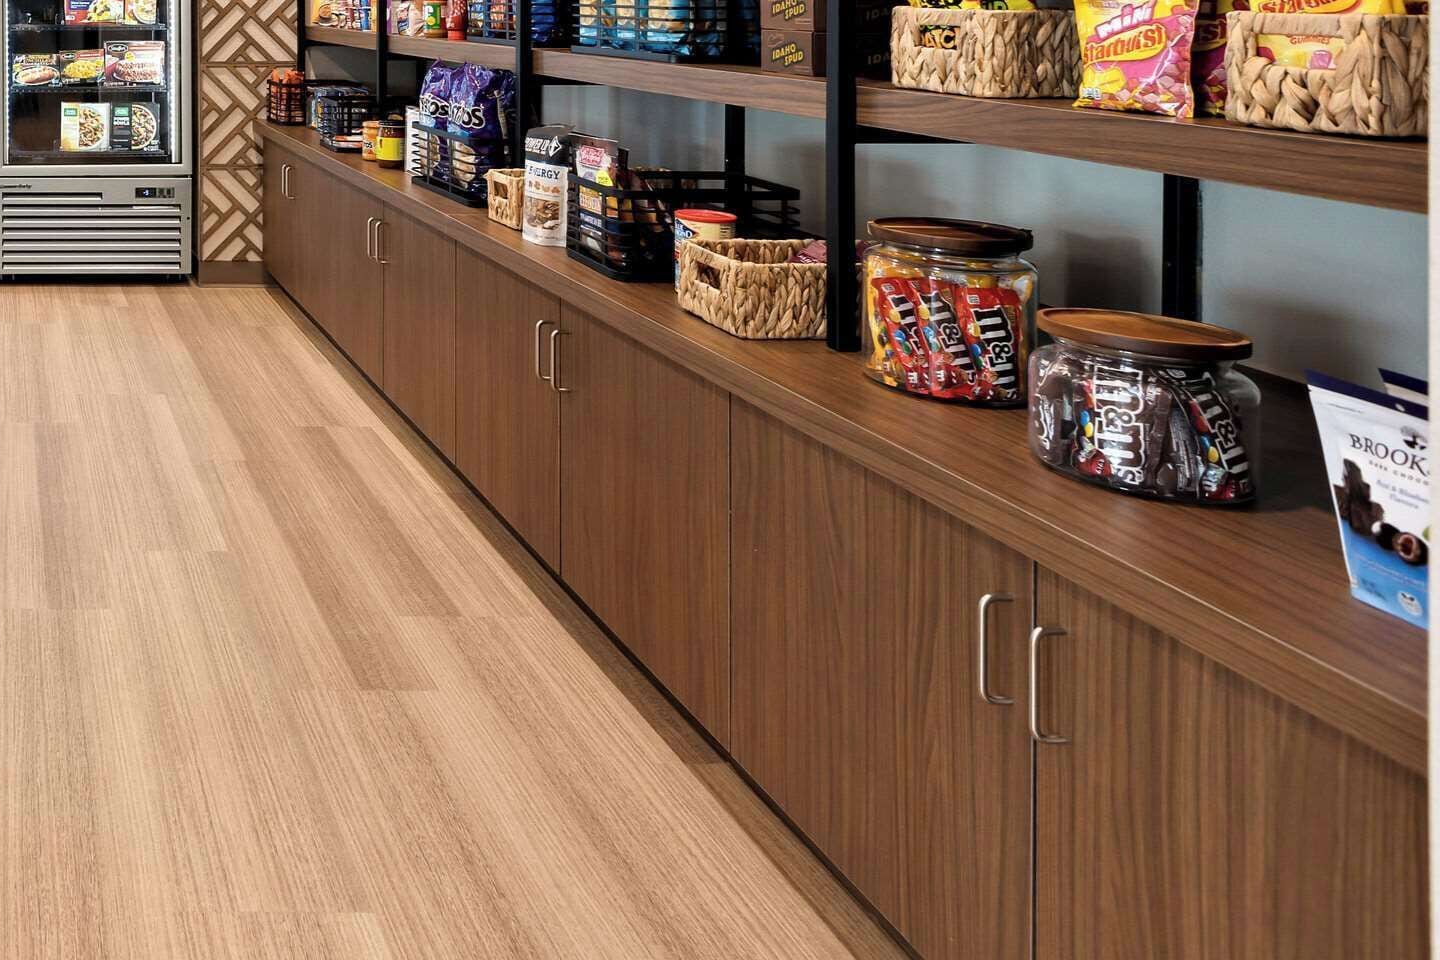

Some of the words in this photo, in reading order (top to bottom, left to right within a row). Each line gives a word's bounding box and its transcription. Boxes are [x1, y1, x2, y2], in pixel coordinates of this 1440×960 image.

[784, 4, 805, 20] SPUD
[1083, 22, 1168, 63] Starburst
[772, 43, 796, 60] IDAHO
[784, 51, 804, 66] SPUD
[529, 166, 561, 180] ENERGY
[1349, 433, 1430, 477] BROOK
